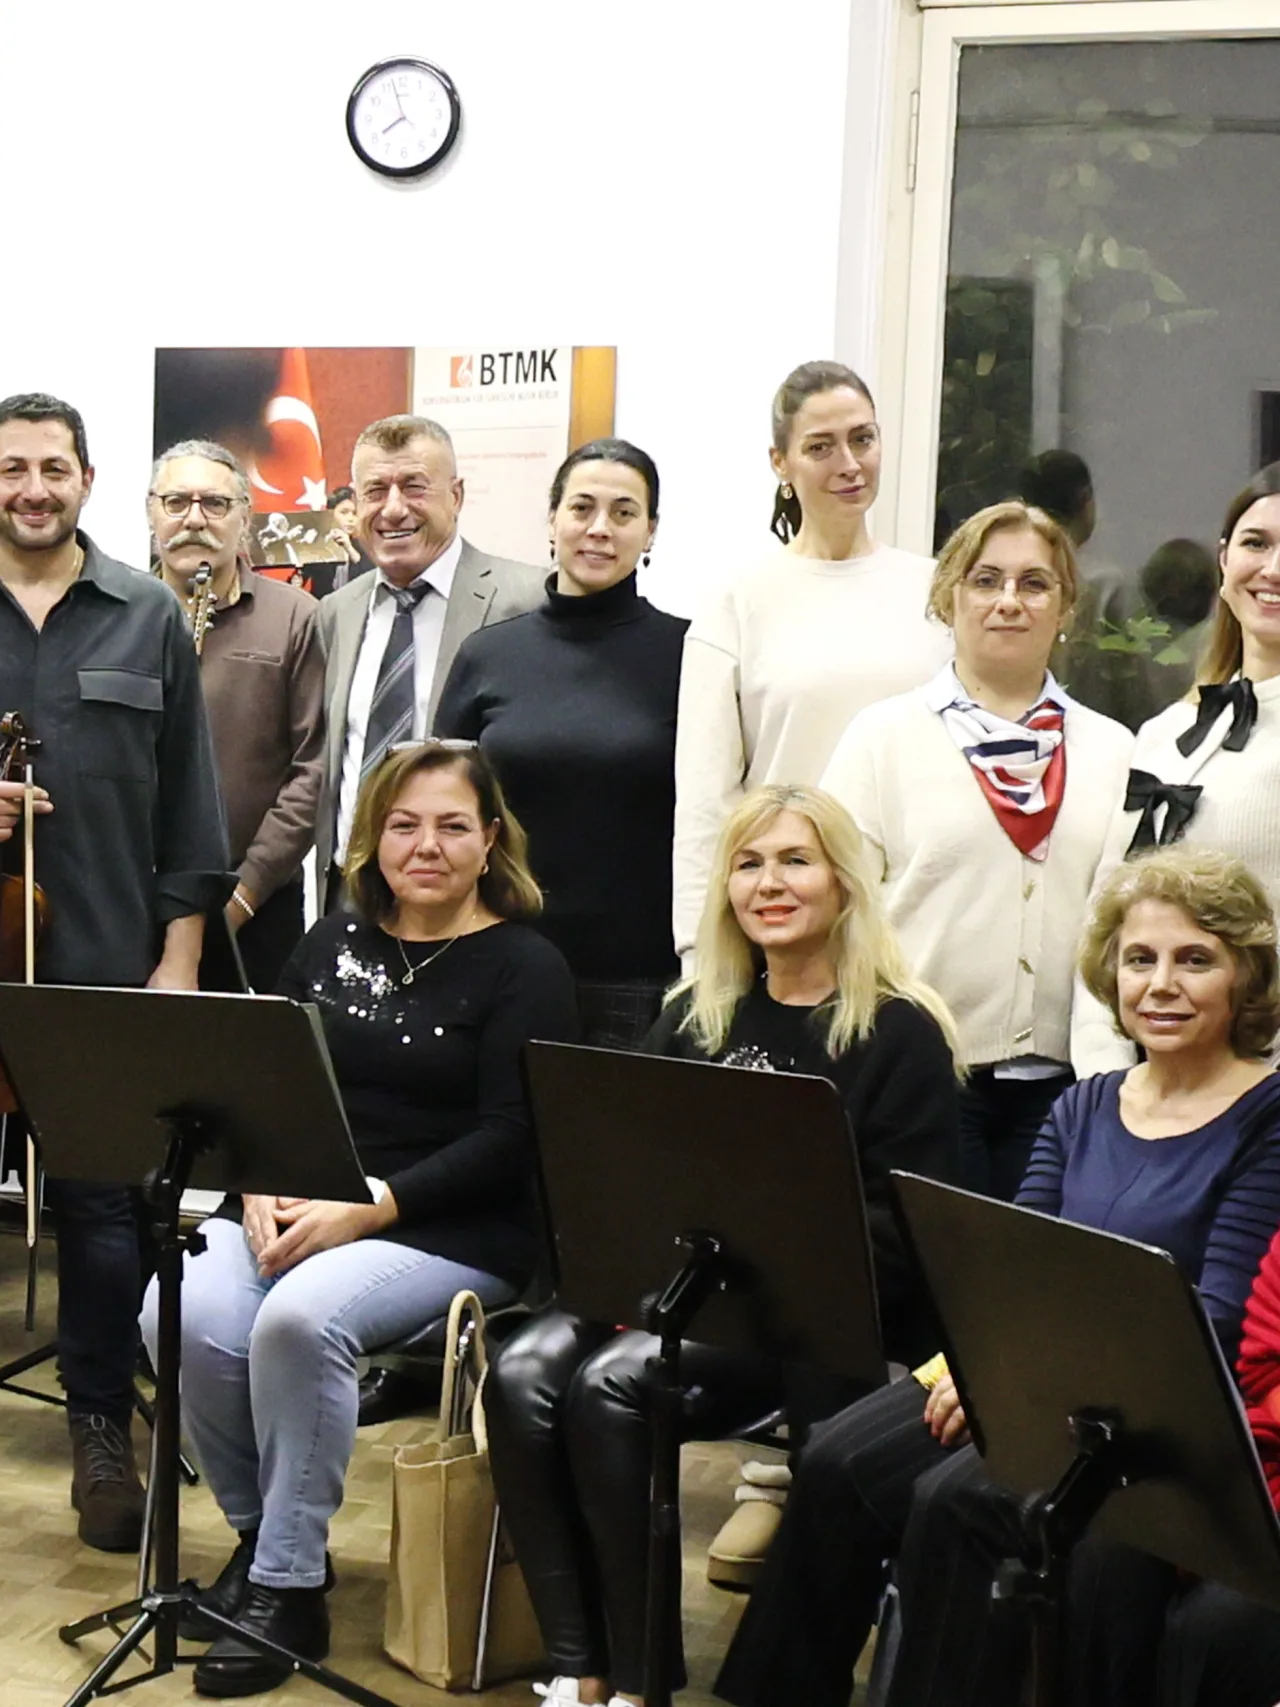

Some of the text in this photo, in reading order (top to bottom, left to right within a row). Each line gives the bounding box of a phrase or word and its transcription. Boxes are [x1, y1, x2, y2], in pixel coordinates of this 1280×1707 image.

[370, 95, 381, 107] 10
[428, 90, 436, 102] 2
[364, 113, 372, 126] 9
[435, 108, 442, 120] 3
[371, 131, 379, 145] 8
[430, 127, 437, 138] 4
[384, 142, 391, 154] 7
[417, 139, 426, 152] 5
[400, 146, 408, 159] 6
[480, 348, 558, 386] BTMK
